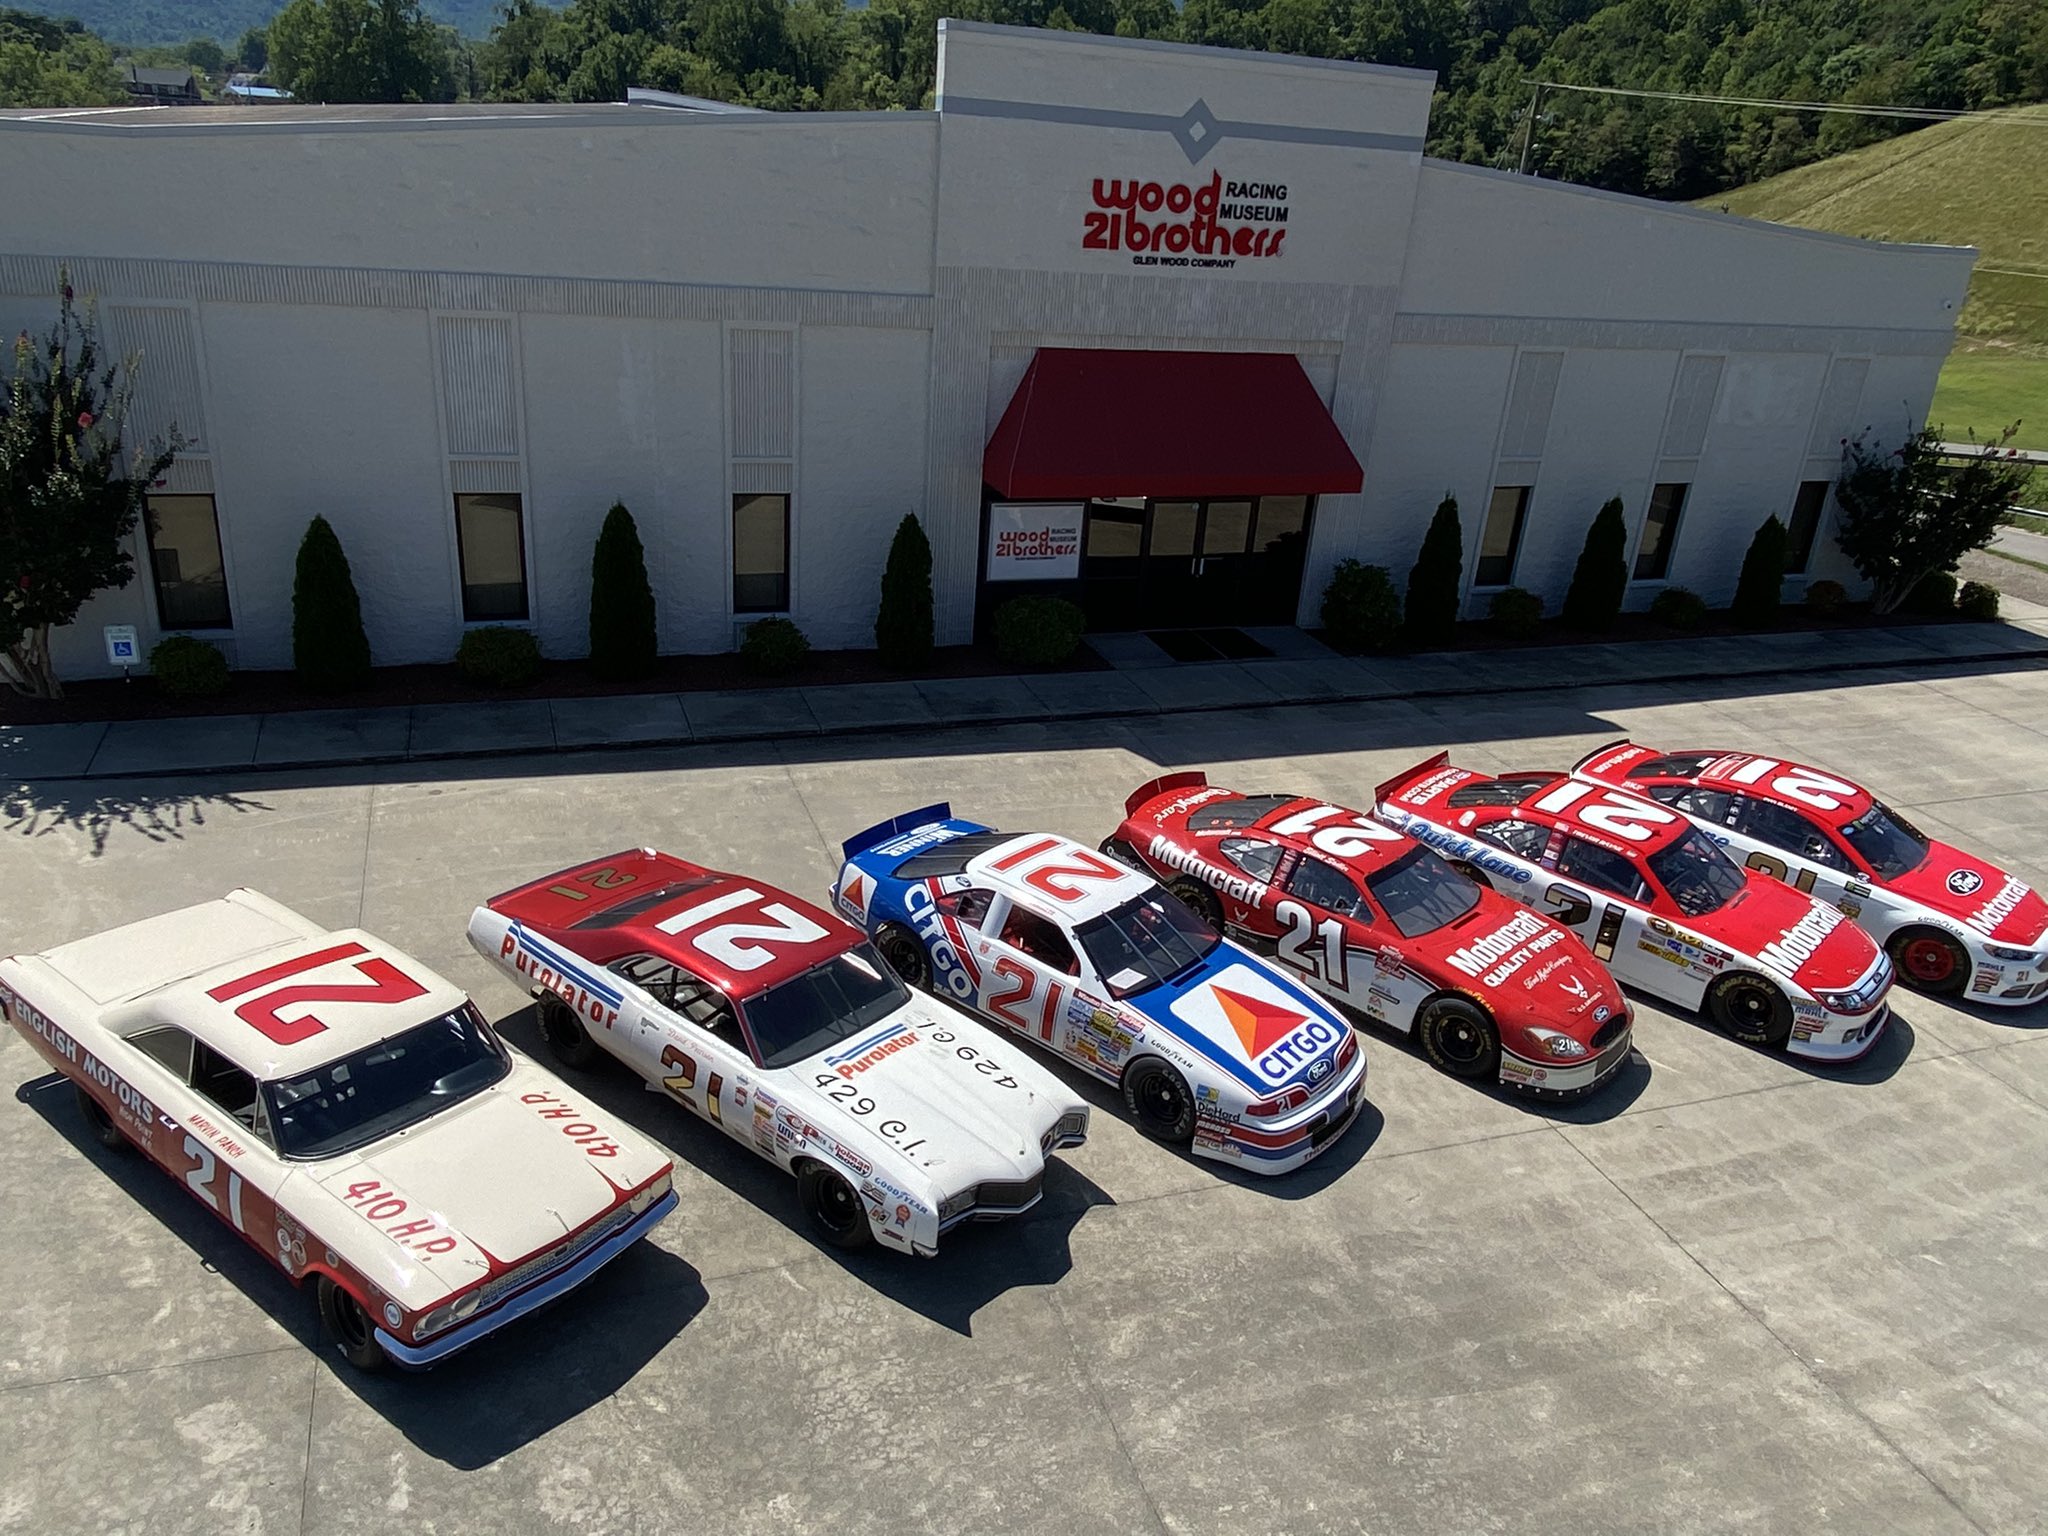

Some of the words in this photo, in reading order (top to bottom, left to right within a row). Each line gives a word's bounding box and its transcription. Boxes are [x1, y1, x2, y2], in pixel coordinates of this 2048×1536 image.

[1092, 168, 1222, 215] wood
[1219, 203, 1288, 222] MUSEUM
[1225, 182, 1287, 200] RACING
[1082, 212, 1121, 250] 21
[1125, 206, 1286, 257] brothers
[1133, 256, 1159, 266] GLEN
[1160, 257, 1189, 267] WOOD
[1191, 258, 1235, 268] COMPANY
[996, 543, 1011, 557] 21
[1012, 541, 1077, 557] brothers
[1000, 526, 1049, 542] wood
[1729, 758, 1858, 811] 21
[1268, 806, 1406, 858] 21
[1534, 781, 1677, 841] 21
[988, 838, 1129, 903] 21
[1148, 834, 1268, 910] Motorcraft
[1407, 821, 1473, 858] Quick
[1470, 847, 1533, 884] Lane
[549, 868, 638, 901] 21
[841, 898, 866, 920] CITGO
[1965, 873, 2031, 936] Motorcraft
[654, 886, 832, 973] 21
[904, 883, 973, 999] CITGO
[1275, 899, 1350, 993] 21
[1445, 909, 1550, 979] Motorcraft
[1544, 882, 1627, 963] 21
[1756, 898, 1846, 979] Motorcraft
[500, 933, 620, 1031] Purolator
[1482, 947, 1534, 988] QUALITY
[1527, 928, 1566, 955] PARTS
[1702, 953, 1725, 970] 3M
[2016, 971, 2029, 982] 21
[206, 941, 430, 1046] 21
[985, 955, 1066, 1045] 21
[15, 997, 77, 1063] ENGLISH
[83, 1052, 154, 1124] MOTORS
[835, 1031, 920, 1081] Purolator
[956, 1046, 1018, 1091] 429
[1259, 1022, 1332, 1079] CITGO
[1558, 1038, 1571, 1052] 21
[660, 1043, 724, 1127] 21
[815, 1073, 876, 1116] 429
[1276, 1095, 1292, 1113] 21
[187, 1113, 217, 1140] MARVIN
[215, 1136, 247, 1160] PANCH
[1197, 1101, 1241, 1123] DieHard
[562, 1123, 620, 1158] 410
[835, 1144, 870, 1171] holman
[835, 1152, 868, 1177] moody
[183, 1134, 245, 1234] 21
[343, 1181, 407, 1220] 410
[874, 1176, 929, 1215] GOODYEAR
